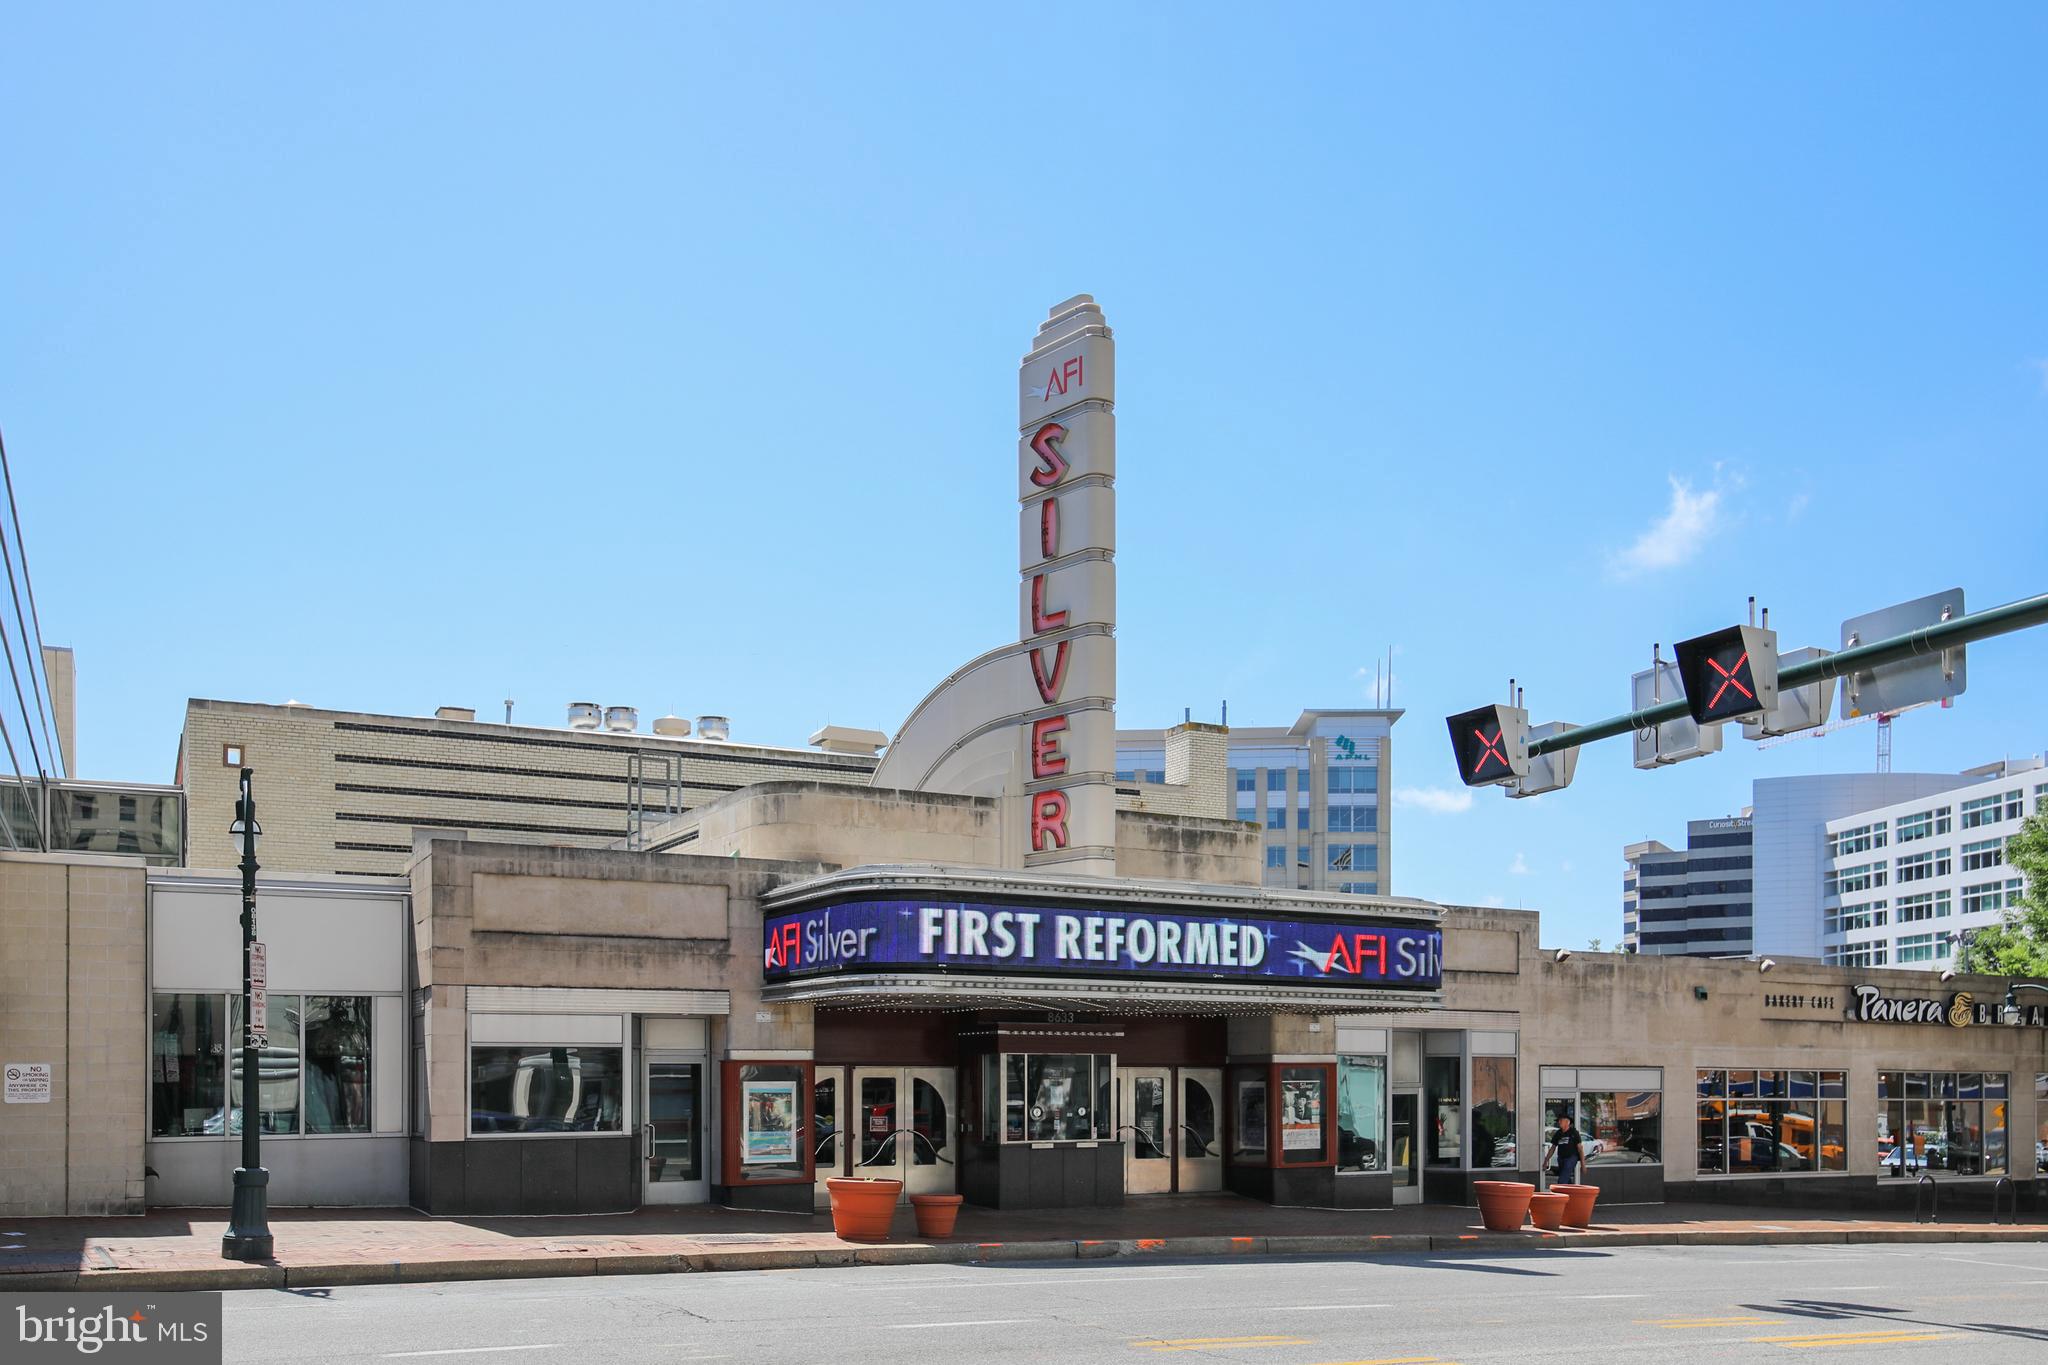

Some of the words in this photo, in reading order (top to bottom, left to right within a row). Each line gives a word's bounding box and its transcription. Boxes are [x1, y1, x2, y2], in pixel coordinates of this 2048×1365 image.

[1044, 355, 1084, 402] AFI
[1030, 421, 1072, 851] SILVER
[1708, 819, 1753, 830] CuriosityStre
[766, 921, 801, 968] AFI
[805, 911, 878, 963] Silver
[918, 908, 1041, 958] FIRST
[1055, 914, 1266, 967] REFORMED
[1324, 932, 1387, 975] AFI
[1047, 1012, 1074, 1023] 8633
[1764, 994, 1804, 1008] BAKERY
[1811, 996, 1835, 1009] CAFE
[1855, 985, 1944, 1023] Panera
